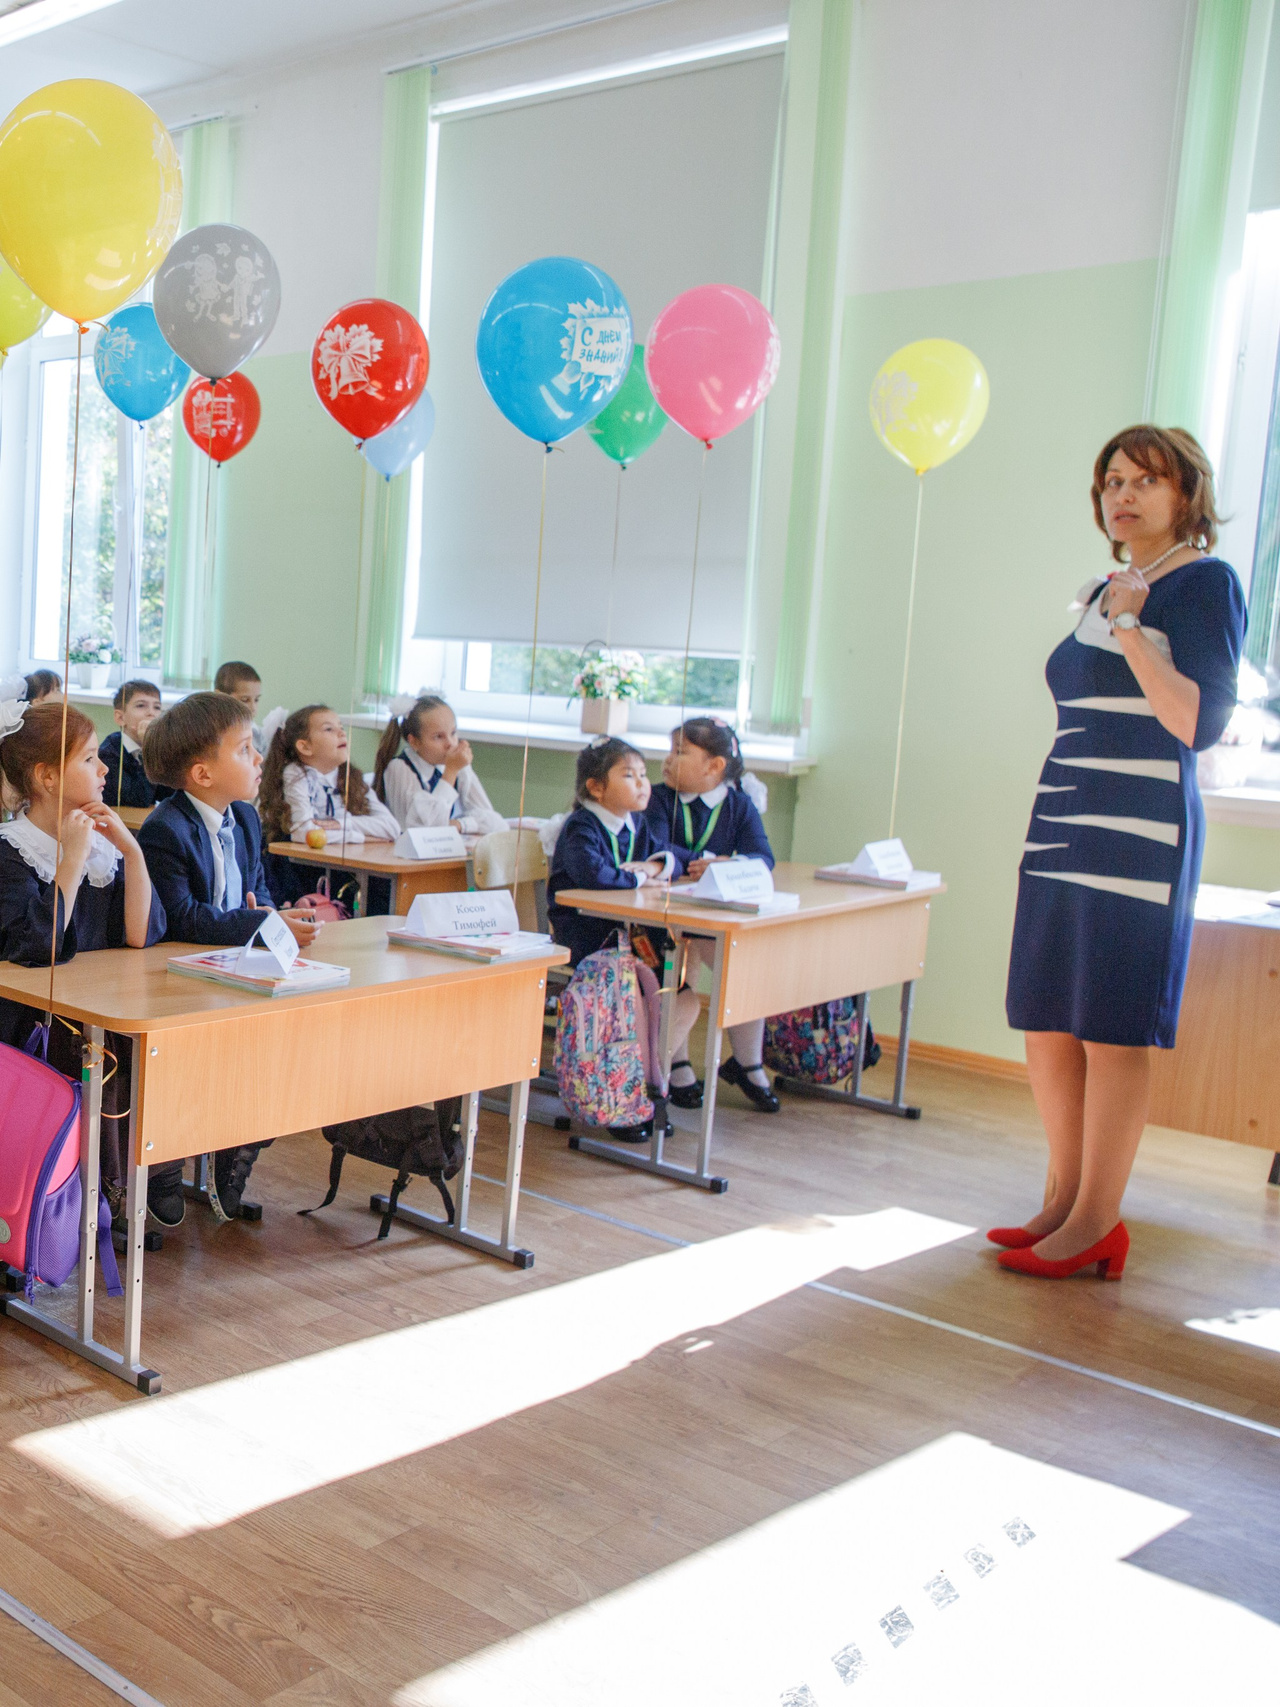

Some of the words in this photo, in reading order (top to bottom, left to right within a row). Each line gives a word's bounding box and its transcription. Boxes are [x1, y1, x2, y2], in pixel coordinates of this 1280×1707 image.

[581, 327, 593, 346] С
[455, 904, 486, 915] Косов
[452, 918, 497, 931] Тимофей
